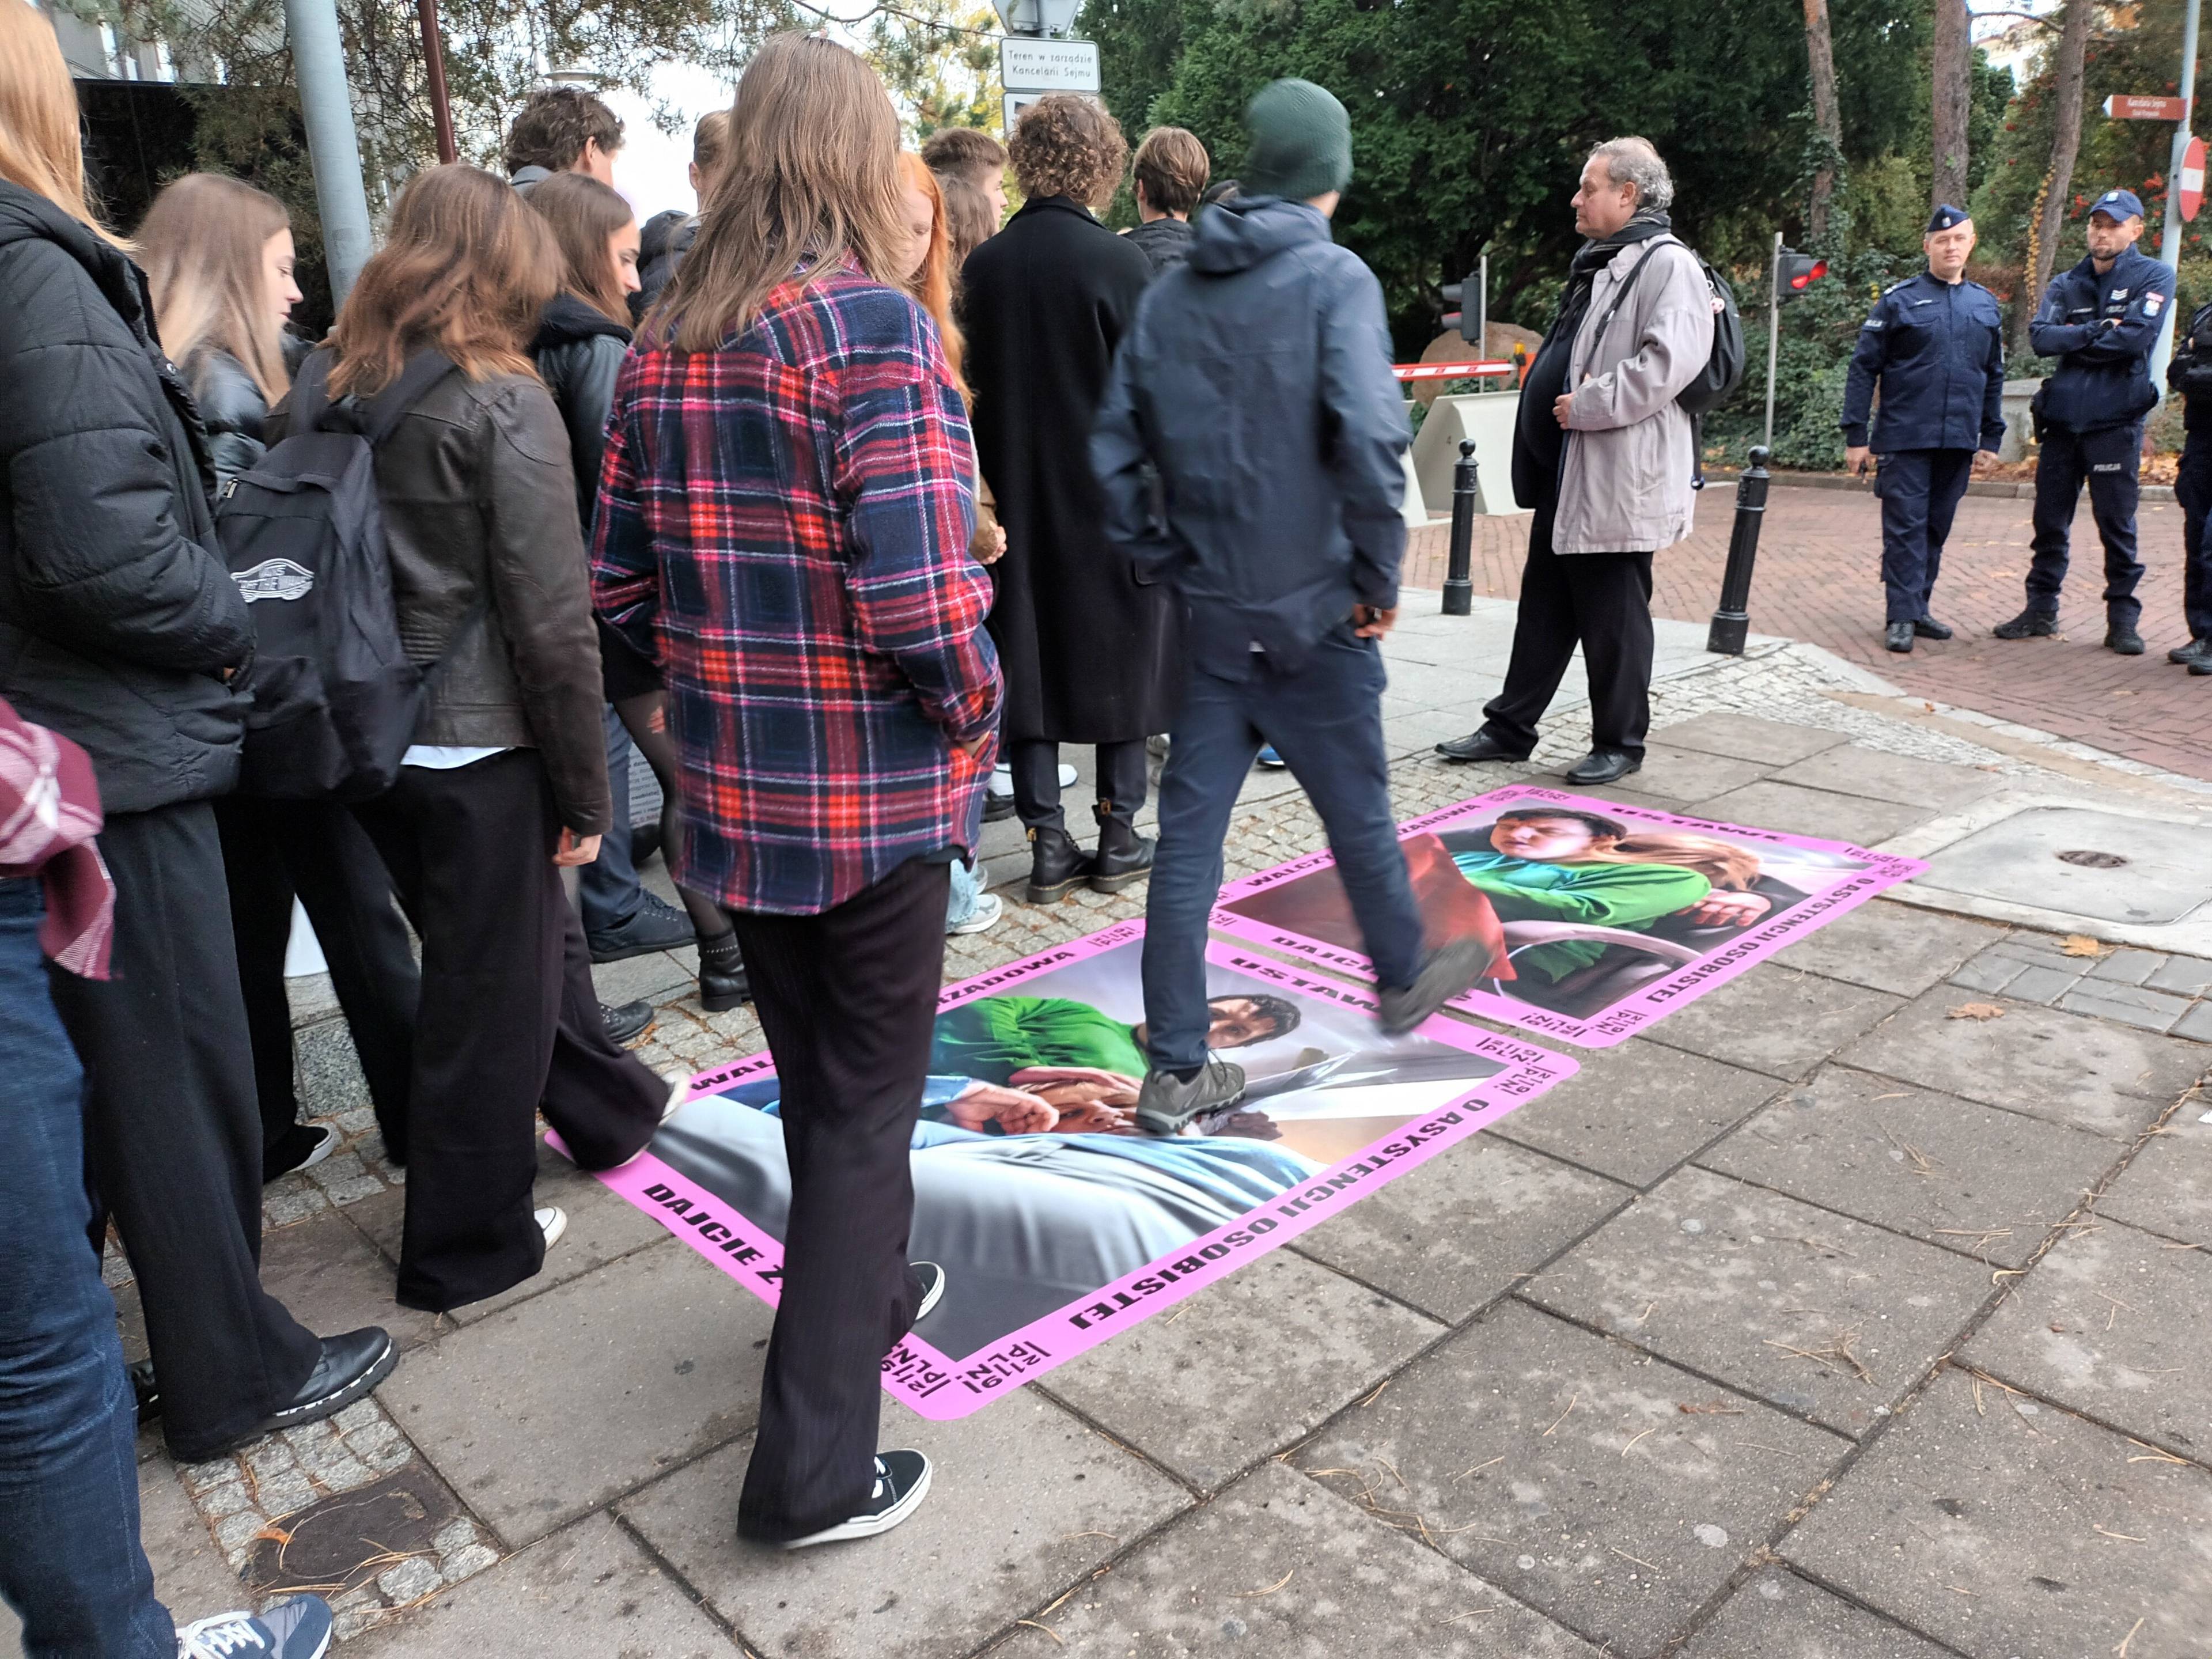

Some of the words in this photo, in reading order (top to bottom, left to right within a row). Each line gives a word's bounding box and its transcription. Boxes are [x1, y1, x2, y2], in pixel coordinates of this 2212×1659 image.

[1009, 50, 1033, 60] Teren
[1051, 53, 1092, 64] zarządzie
[1012, 65, 1059, 77] Kancelarii
[1065, 67, 1090, 79] Sejmu
[1646, 941, 1760, 1003] OSOBISTEJ
[1461, 1098, 1490, 1112] O
[1277, 1112, 1463, 1218] ASYSTENCJI
[642, 1183, 765, 1266] DAJCIE
[1067, 1217, 1279, 1330] OSOBISTEJ
